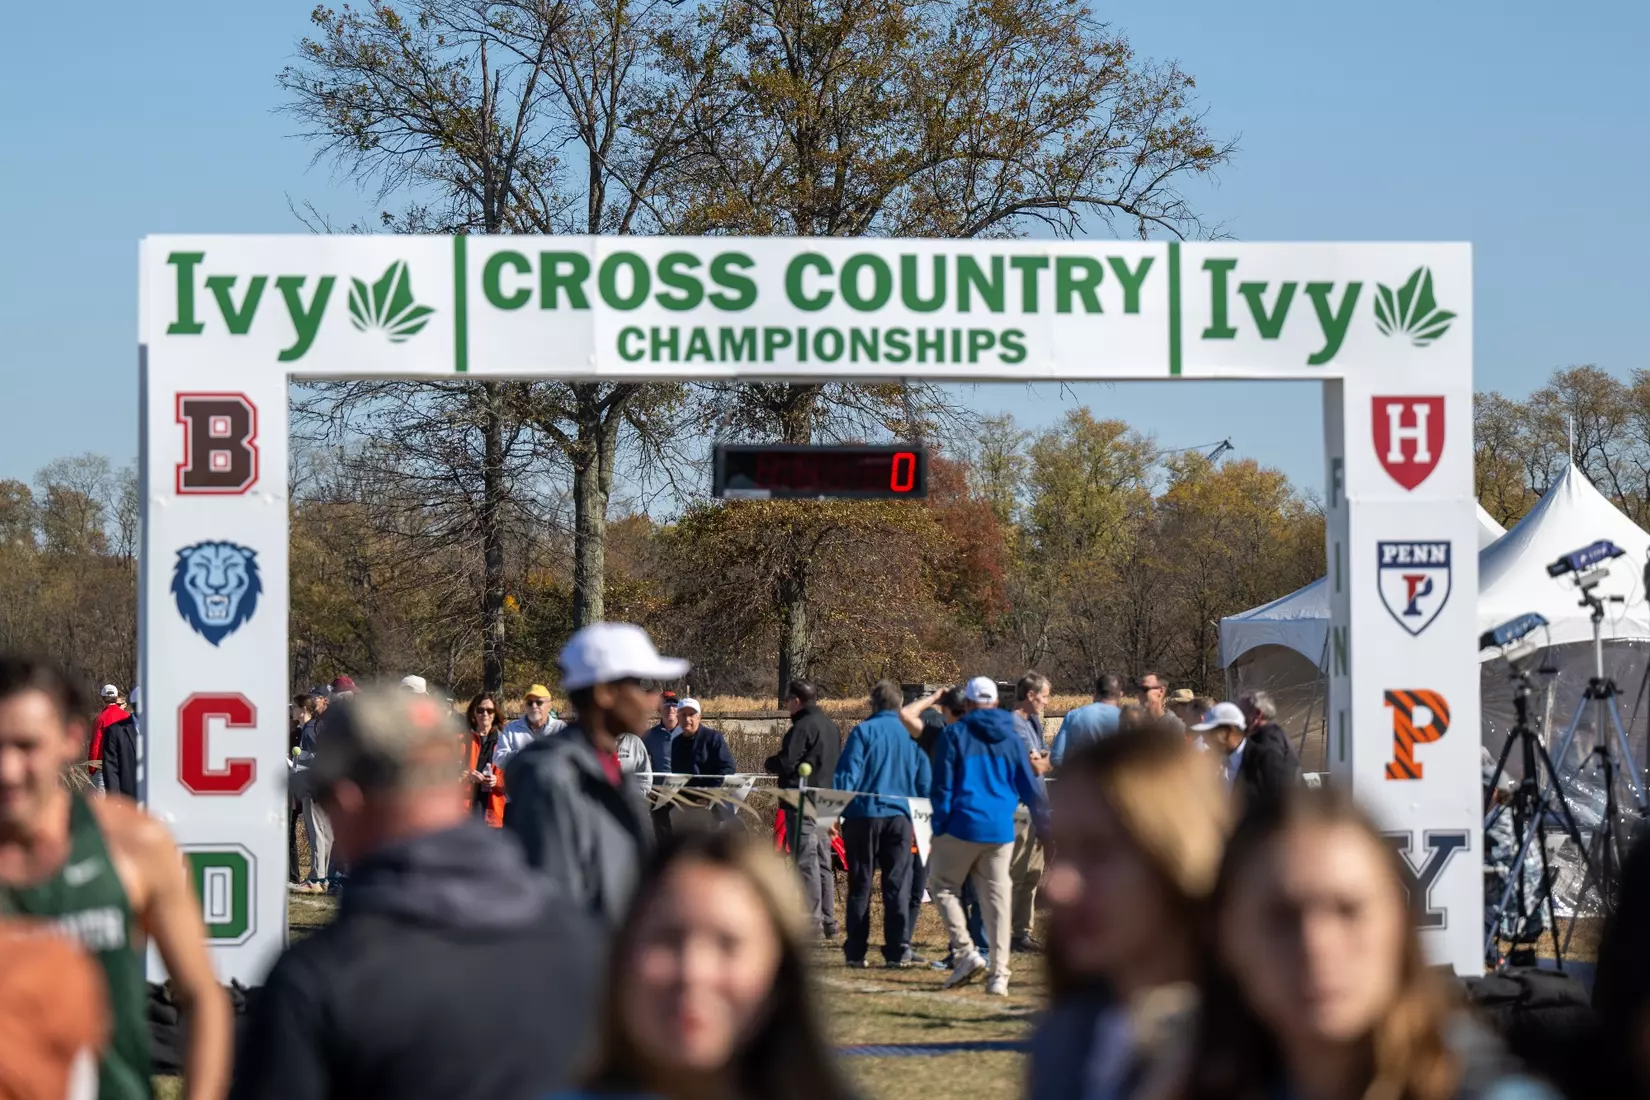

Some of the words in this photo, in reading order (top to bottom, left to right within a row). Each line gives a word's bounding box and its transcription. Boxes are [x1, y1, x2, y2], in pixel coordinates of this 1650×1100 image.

[166, 251, 336, 362] Ivy
[482, 250, 758, 312] CROSS
[785, 252, 1154, 315] COUNTRY
[1201, 258, 1363, 366] Ivy
[617, 326, 1028, 364] CHAMPIONSHIPS
[175, 391, 259, 495] B
[890, 452, 916, 493] 0
[1386, 404, 1430, 463] H
[1382, 543, 1448, 564] PENN
[1402, 574, 1433, 616] P
[177, 692, 257, 796] C
[1384, 688, 1451, 781] P
[914, 809, 930, 823] Ivy
[182, 843, 257, 946] D
[1380, 828, 1471, 931] Y
